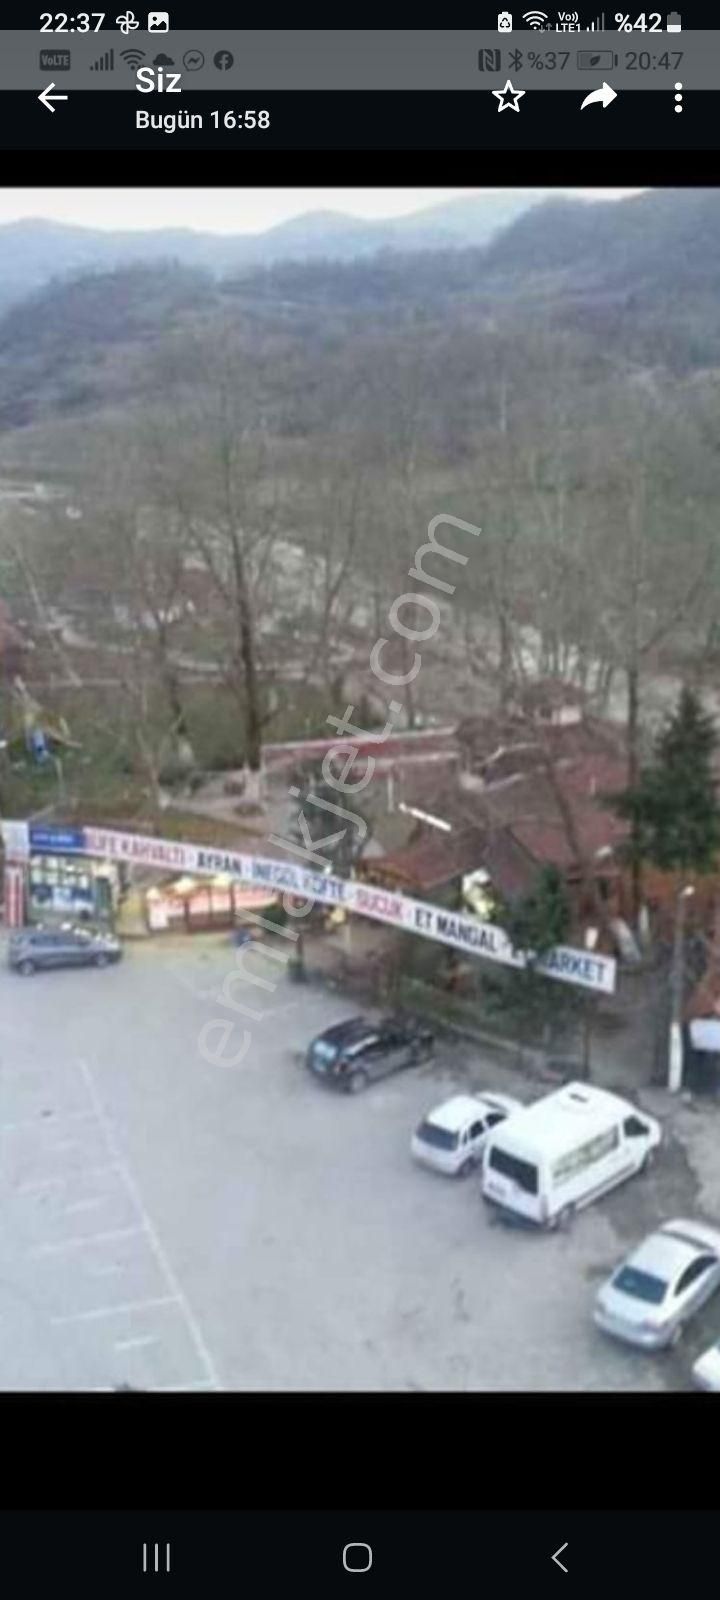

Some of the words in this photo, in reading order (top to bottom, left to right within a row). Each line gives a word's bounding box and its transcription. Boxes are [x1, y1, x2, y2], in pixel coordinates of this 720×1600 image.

[197, 852, 242, 875] AYRAN
[356, 889, 404, 920] SUCUK
[415, 908, 433, 929] ET
[438, 911, 498, 953] MANGAL
